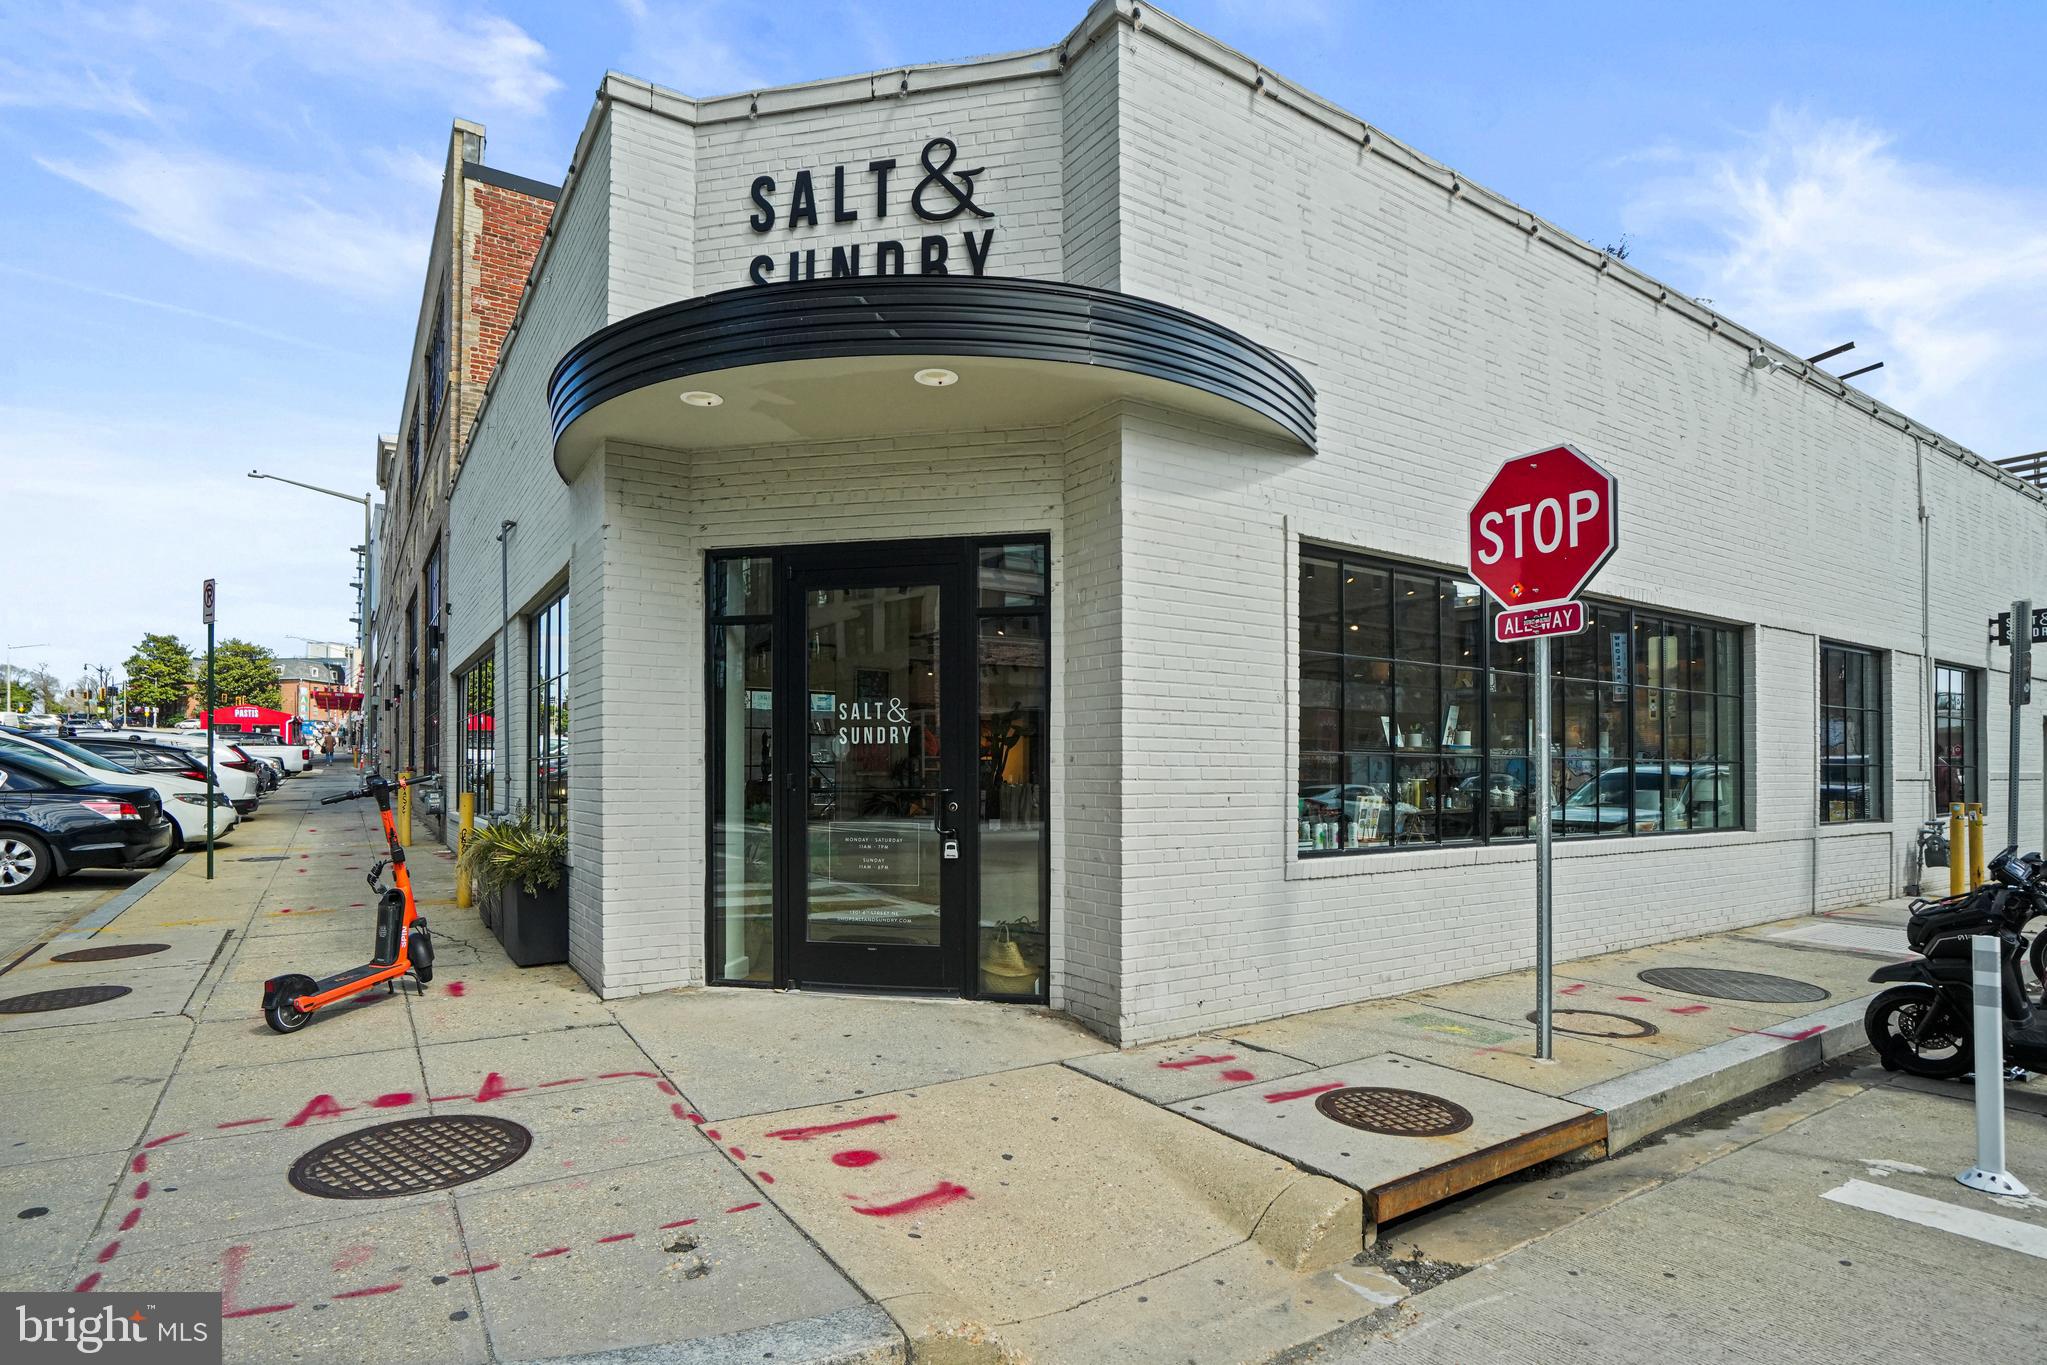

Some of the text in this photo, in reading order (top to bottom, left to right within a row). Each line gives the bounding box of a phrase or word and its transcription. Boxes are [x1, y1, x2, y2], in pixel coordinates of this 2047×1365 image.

[750, 137, 995, 233] SALT &
[1477, 489, 1600, 565] STOP
[234, 709, 259, 718] PASTIS
[839, 702, 884, 720] SALT
[887, 697, 912, 724] &
[839, 726, 912, 744] SUNDRY
